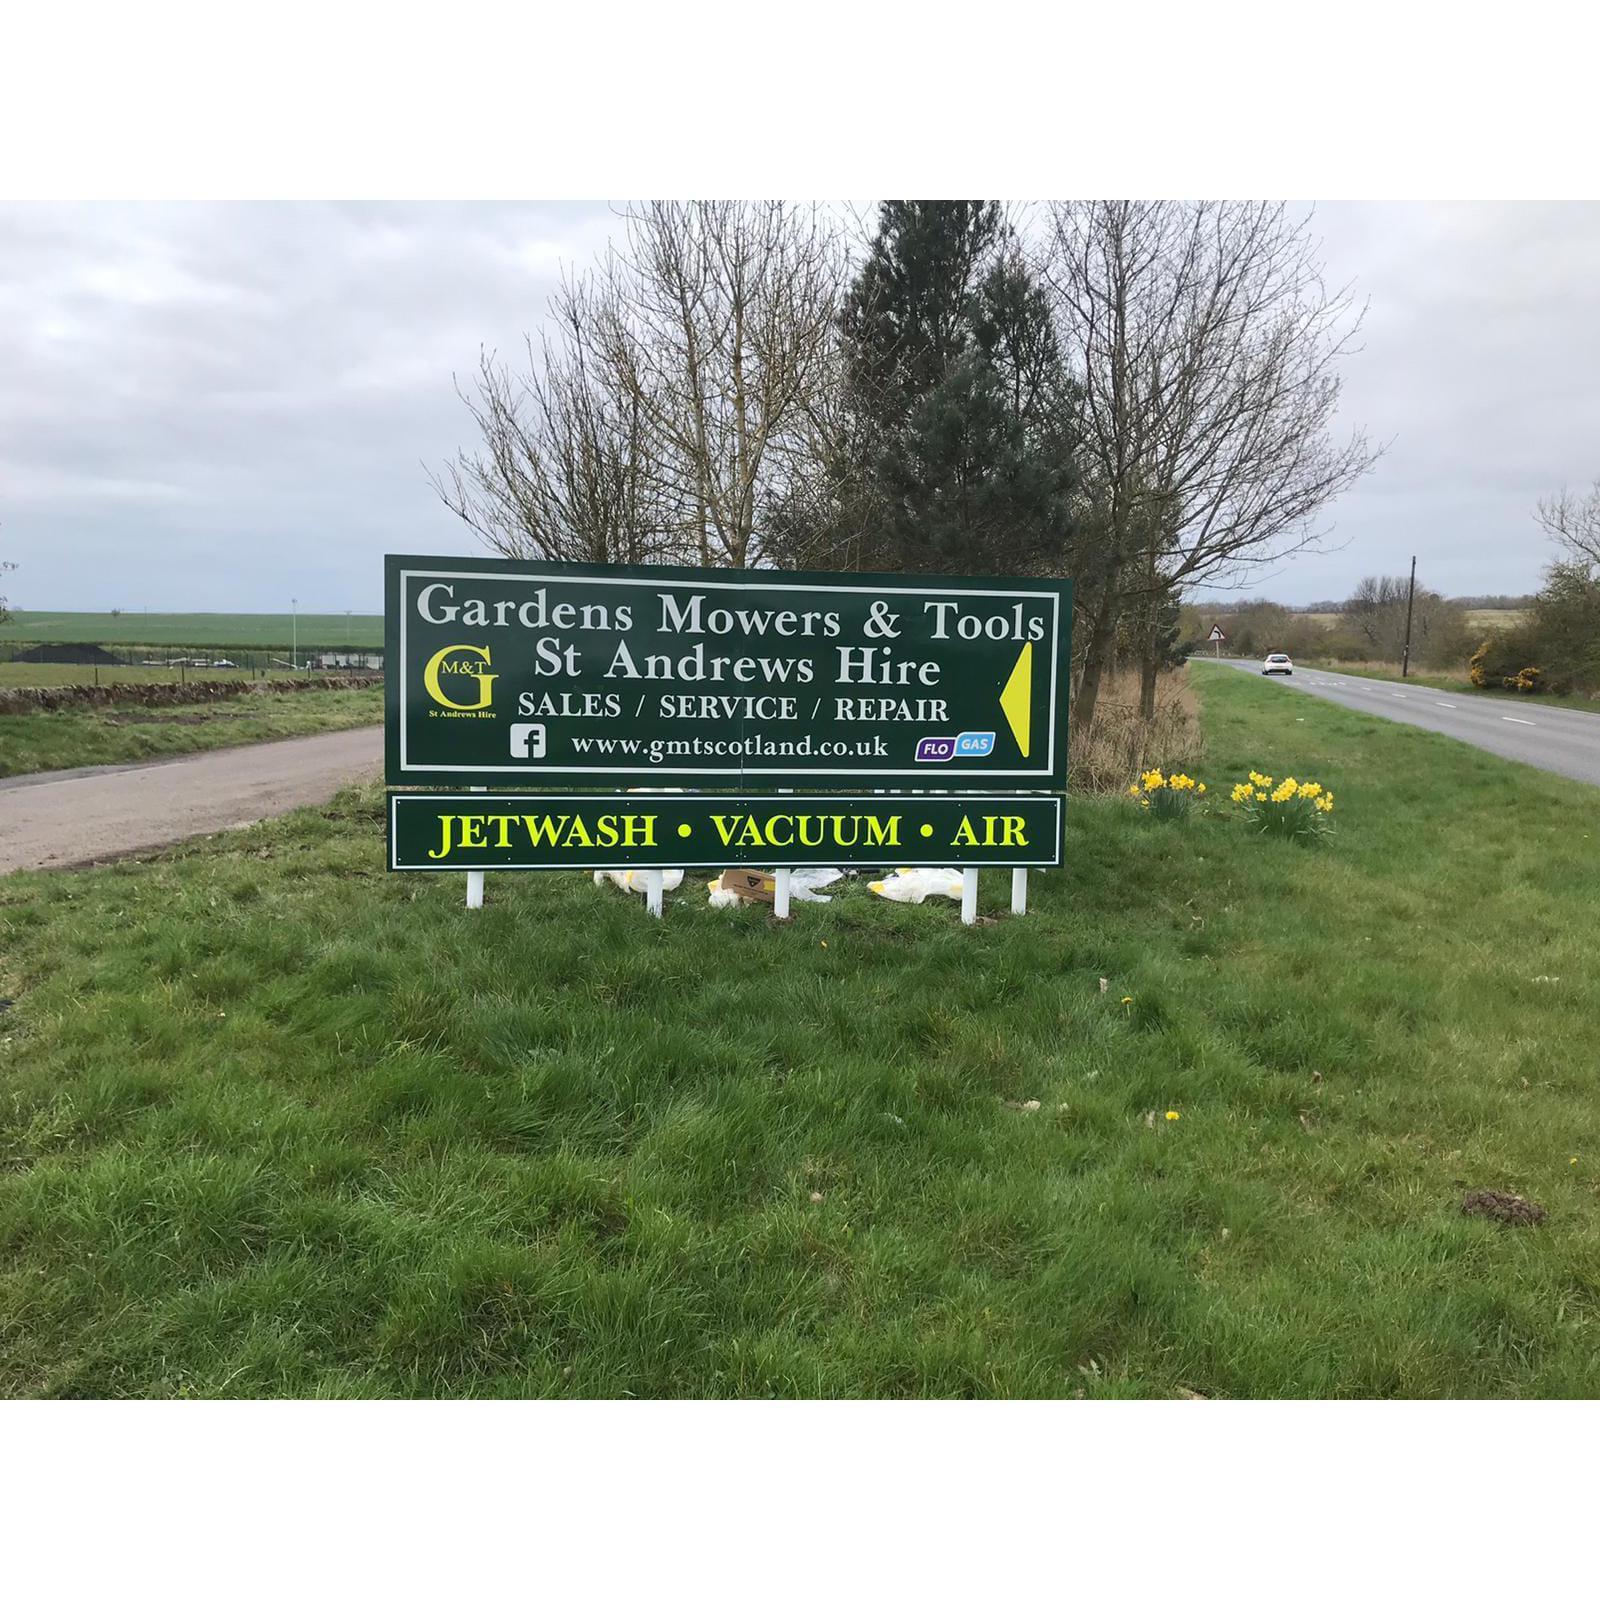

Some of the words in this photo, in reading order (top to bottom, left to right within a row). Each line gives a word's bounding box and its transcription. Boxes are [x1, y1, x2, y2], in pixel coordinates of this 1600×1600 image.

[417, 583, 633, 632] Gardens
[656, 593, 841, 637] Mowers
[863, 600, 901, 639] &
[923, 602, 1045, 641] Tools
[441, 660, 487, 674] M&T
[535, 637, 582, 677] St
[603, 639, 814, 683] Andrews
[835, 646, 941, 686] Hire
[423, 644, 499, 710] G
[429, 709, 437, 718] St
[440, 710, 475, 719] Andrews
[478, 711, 497, 719] Hire
[518, 692, 621, 718] SALES
[659, 694, 798, 720] SERVICE
[834, 697, 950, 722] REPAIR
[571, 734, 889, 763] www.gmtscotland.co.uk
[923, 742, 949, 755] FLO
[961, 737, 989, 750] GAS
[428, 814, 656, 860] JETWASH
[709, 814, 901, 847] VACUUM
[949, 815, 1029, 847] AIR
